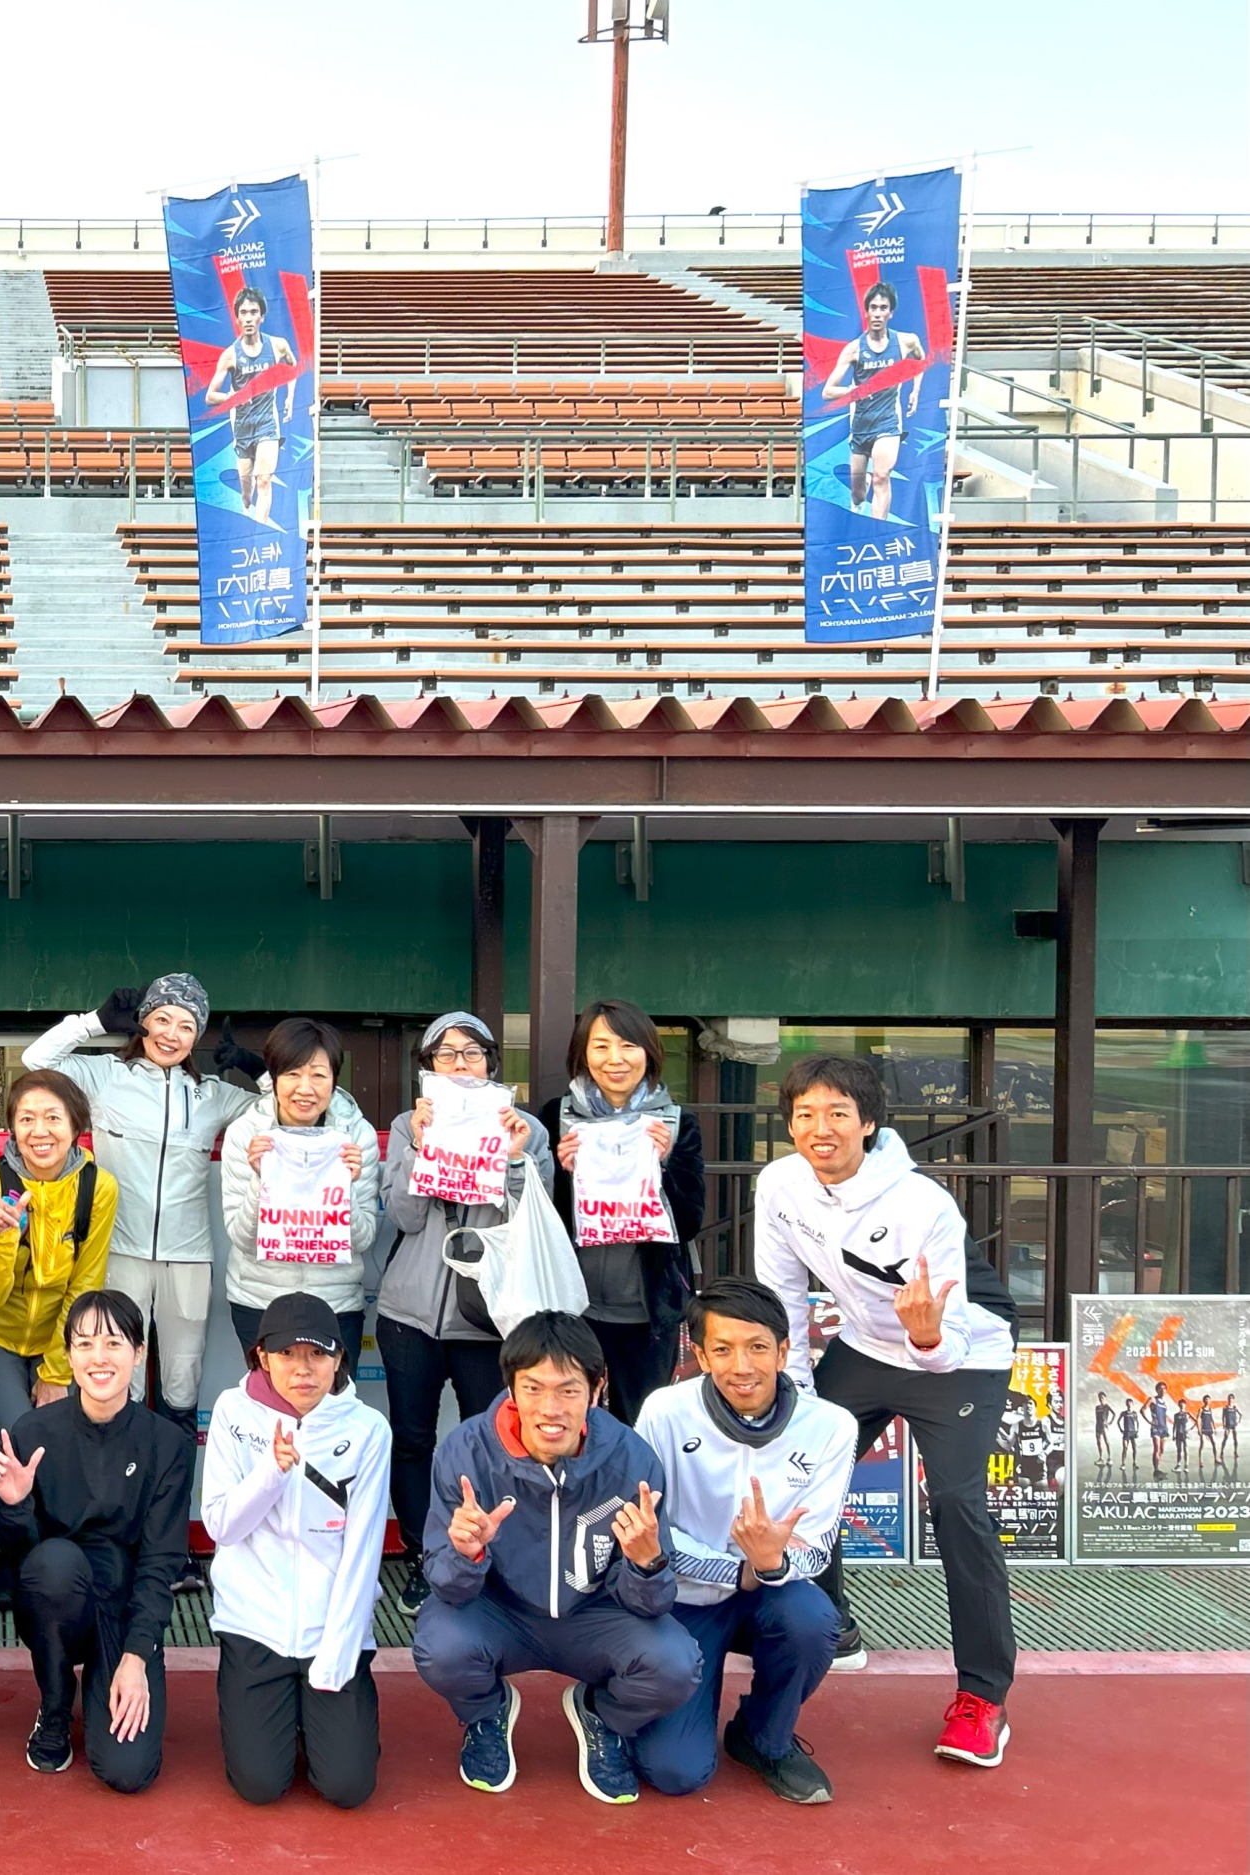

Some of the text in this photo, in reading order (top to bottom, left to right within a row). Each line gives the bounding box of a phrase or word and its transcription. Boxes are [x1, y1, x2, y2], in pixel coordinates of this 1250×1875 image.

[478, 1136, 502, 1154] 10
[322, 1186, 344, 1206] 10
[283, 1227, 324, 1239] WITH
[265, 1250, 337, 1263] FOREVER
[1082, 1334, 1094, 1347] 9
[1195, 1346, 1215, 1357] SUN
[1031, 1351, 1046, 1396] 超えて
[1029, 1442, 1036, 1453] 9
[1033, 1491, 1057, 1501] SUN
[1082, 1505, 1250, 1519] SAKU.AC 2023
